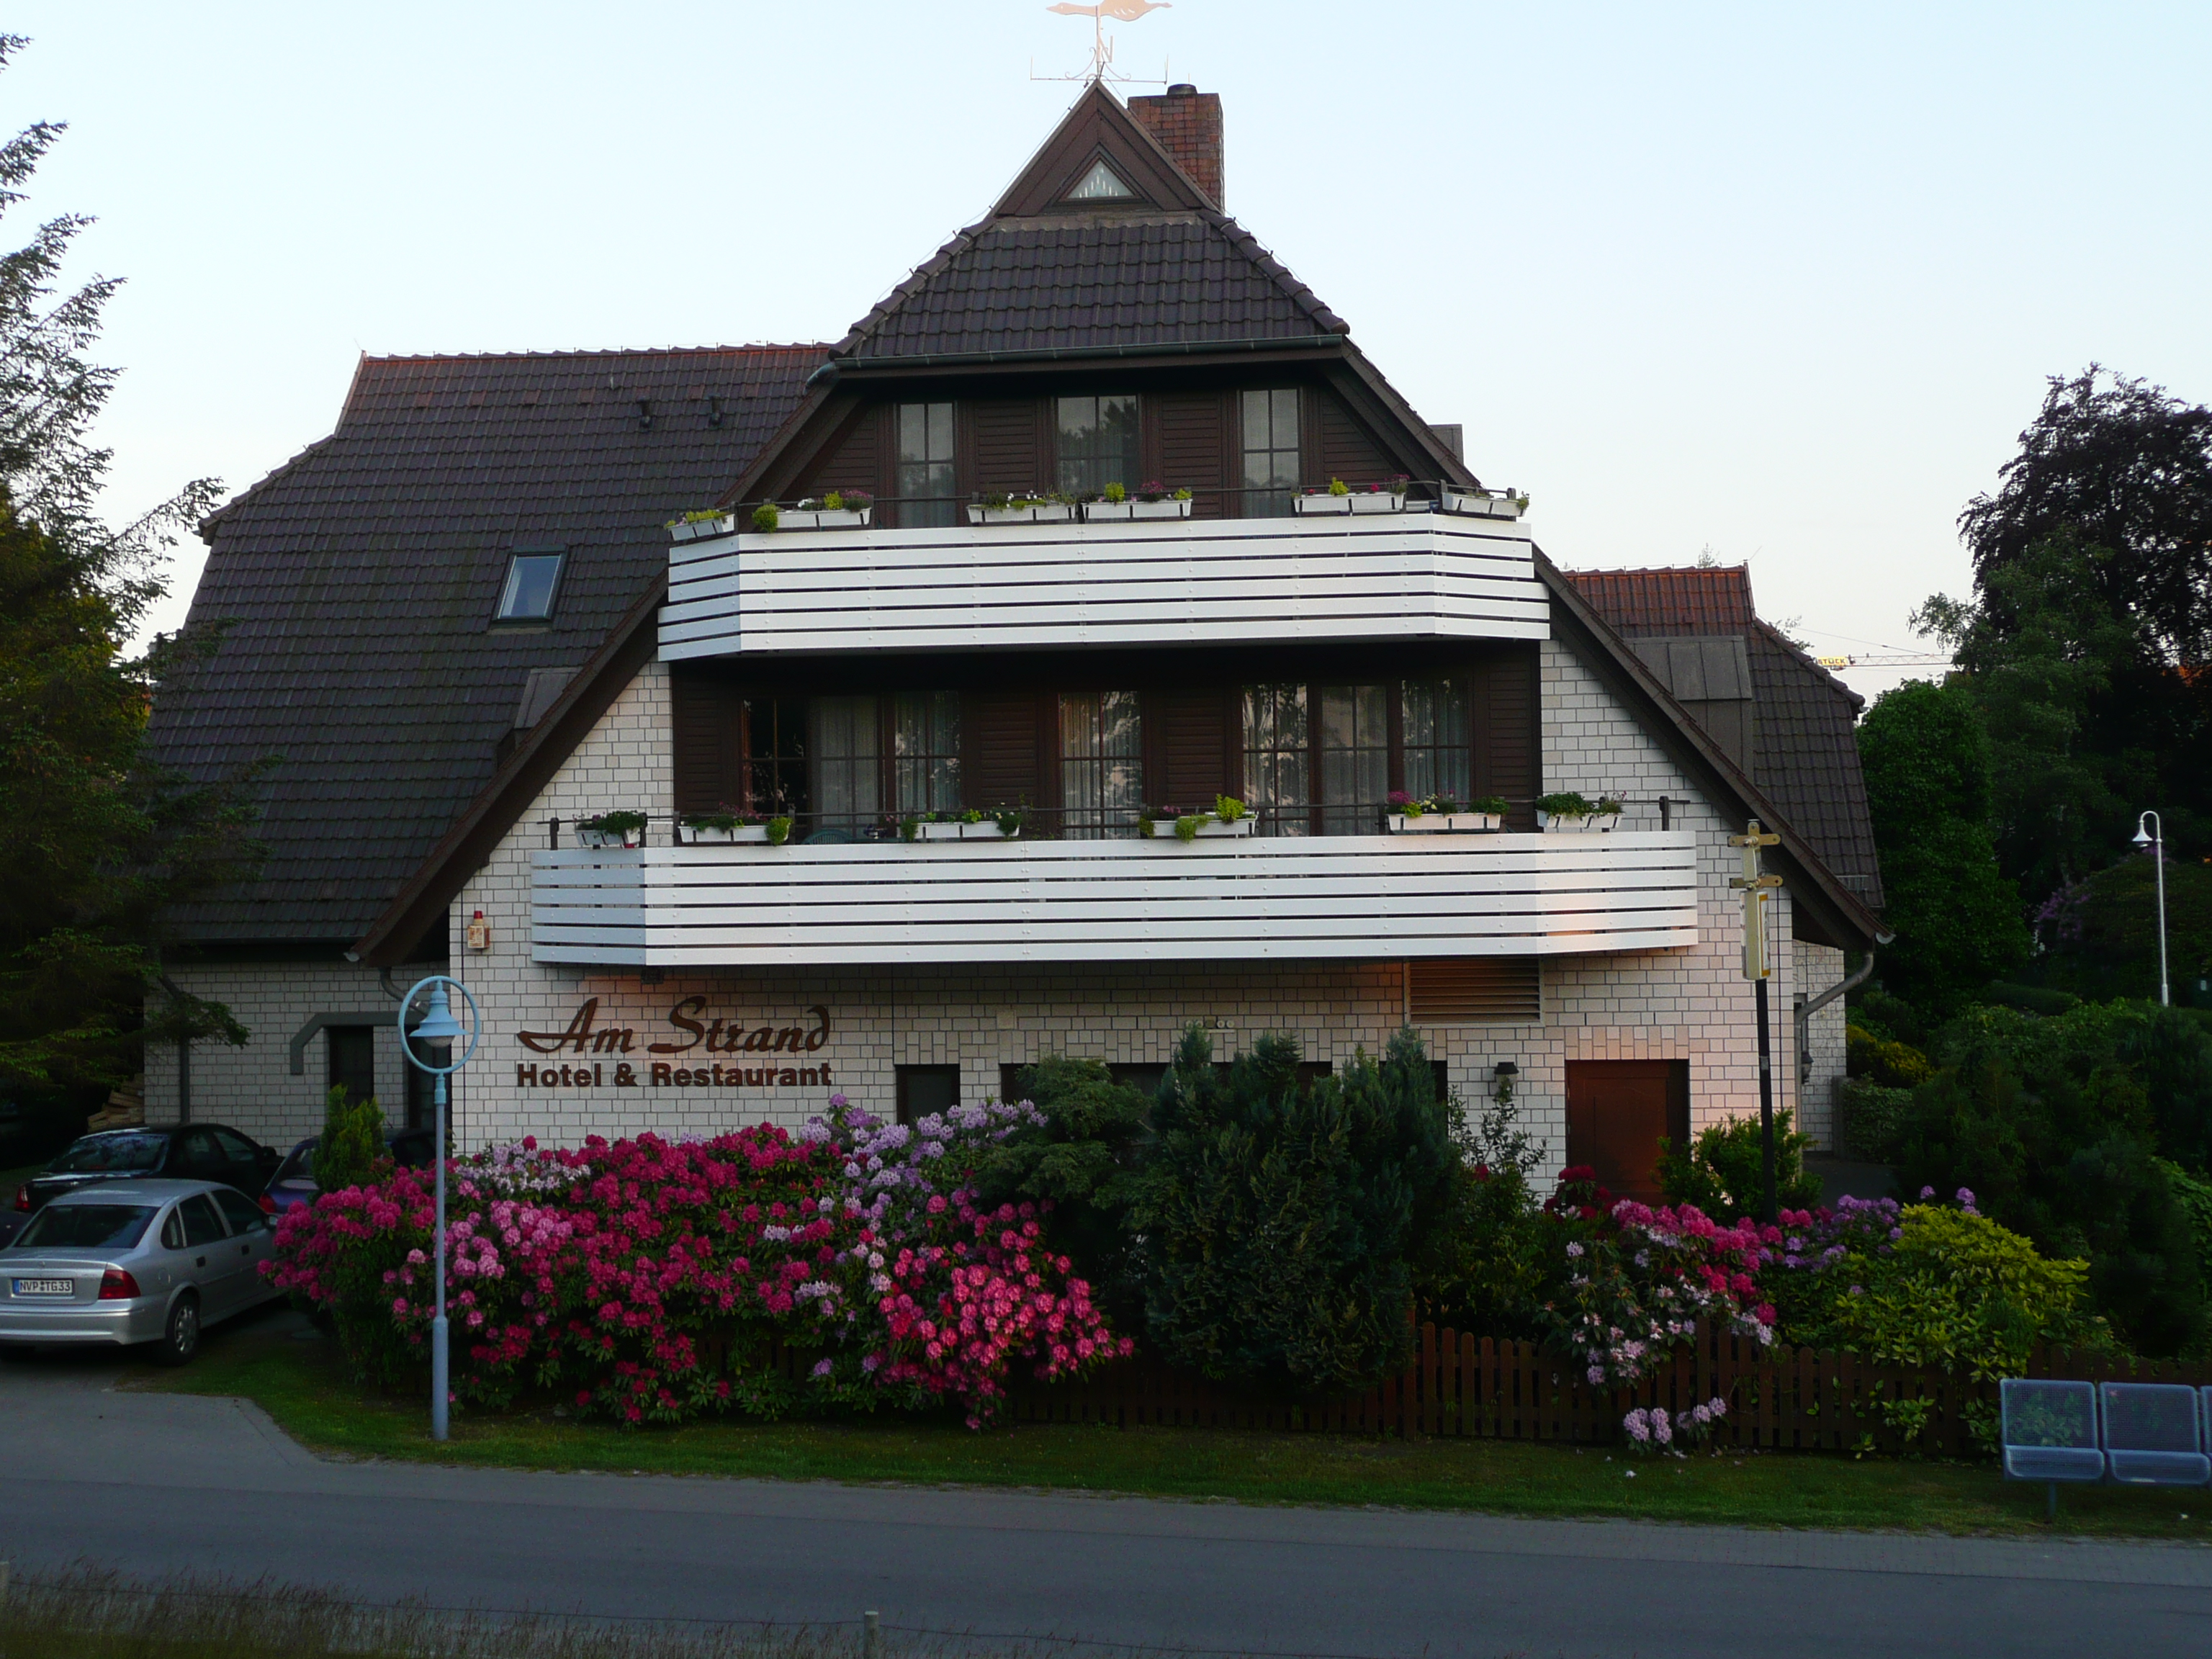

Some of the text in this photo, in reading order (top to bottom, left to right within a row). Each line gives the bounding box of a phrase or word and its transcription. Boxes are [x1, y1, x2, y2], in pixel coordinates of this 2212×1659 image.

[516, 995, 831, 1053] Am Strand
[516, 1061, 833, 1087] Hotel & Restaurant
